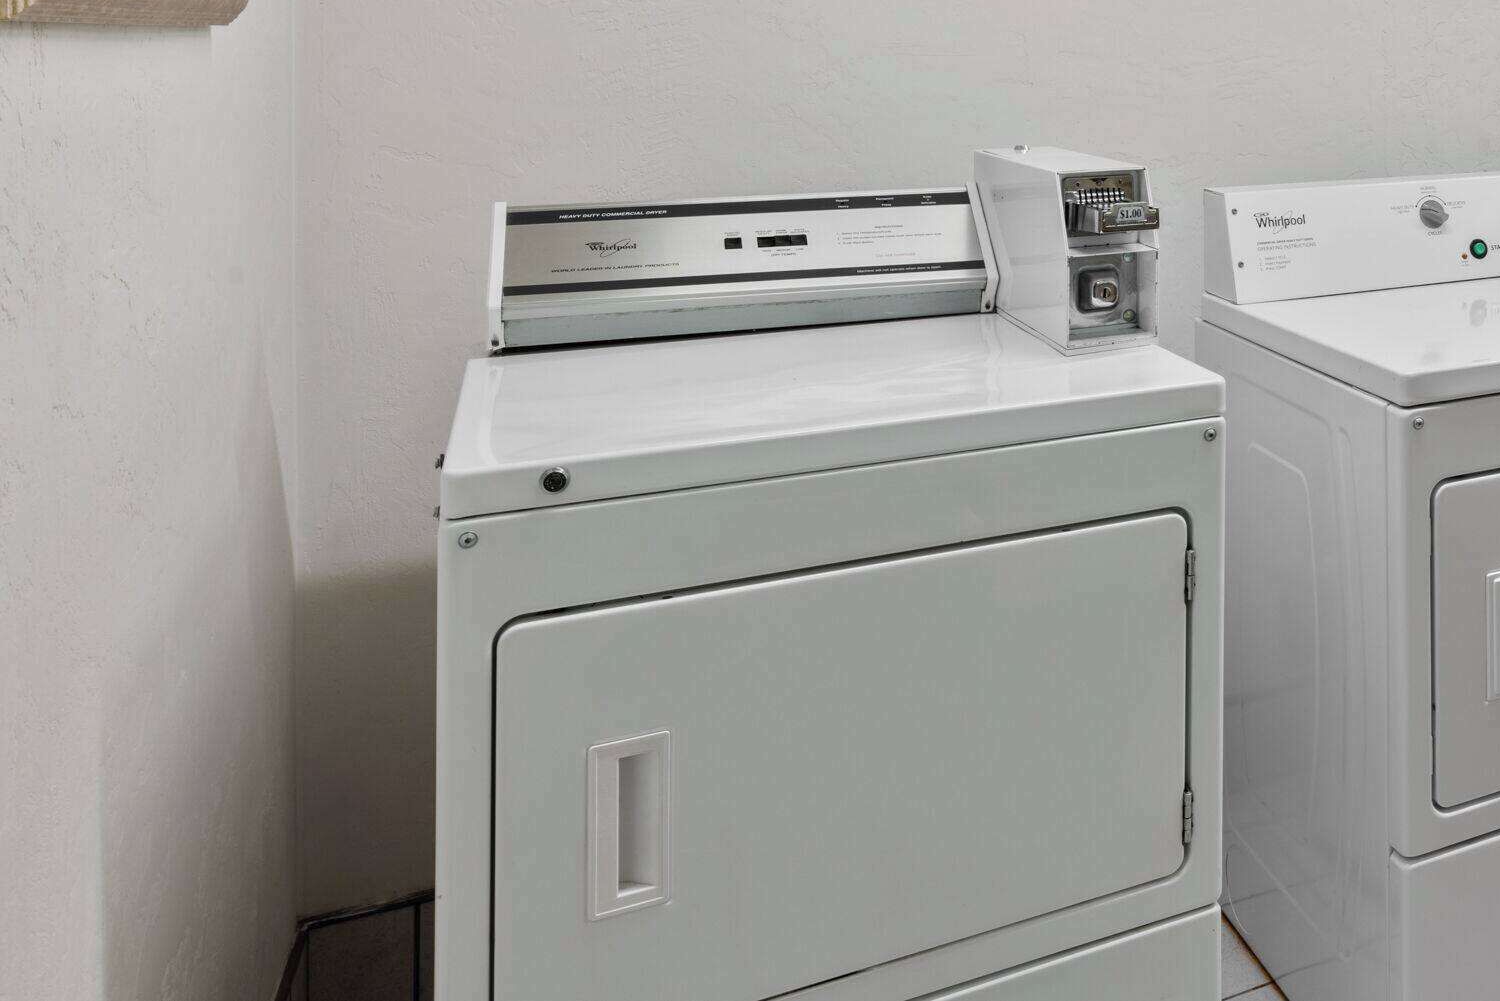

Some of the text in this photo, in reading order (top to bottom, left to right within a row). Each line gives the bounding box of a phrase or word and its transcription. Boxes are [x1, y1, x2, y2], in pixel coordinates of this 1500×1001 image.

[601, 210, 645, 218] COMMERCIAL
[1120, 208, 1142, 219] $1.00
[1254, 213, 1306, 230] Whirlpool
[586, 241, 637, 254] Whirlpool
